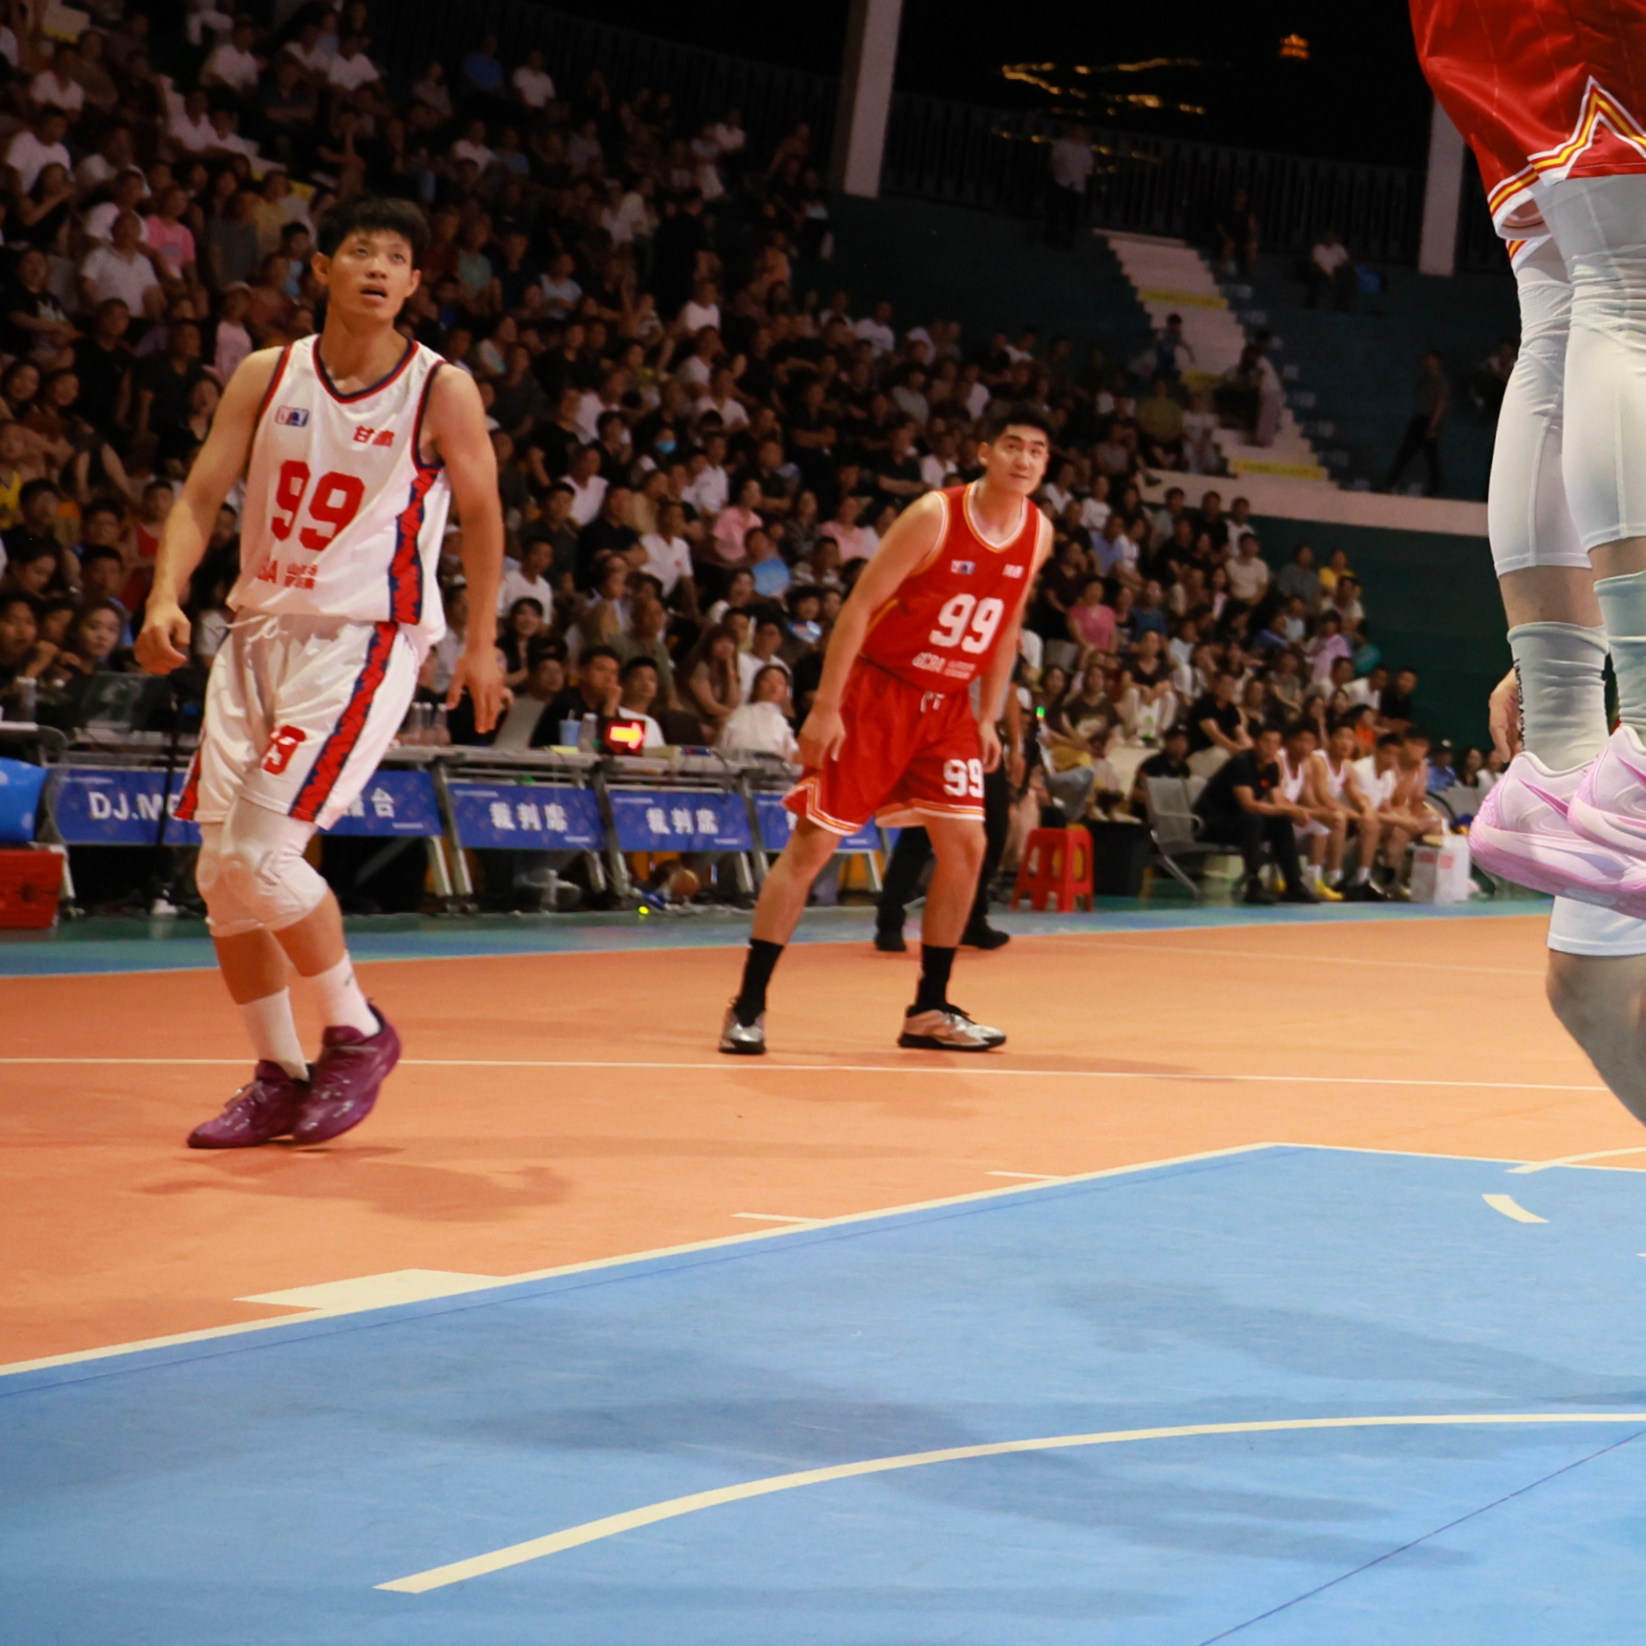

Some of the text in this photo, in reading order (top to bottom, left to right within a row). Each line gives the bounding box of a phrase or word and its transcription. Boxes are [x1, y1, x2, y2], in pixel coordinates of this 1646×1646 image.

[271, 460, 366, 553] 99
[929, 593, 1004, 654] 99
[262, 725, 307, 775] 9
[943, 758, 984, 798] 99
